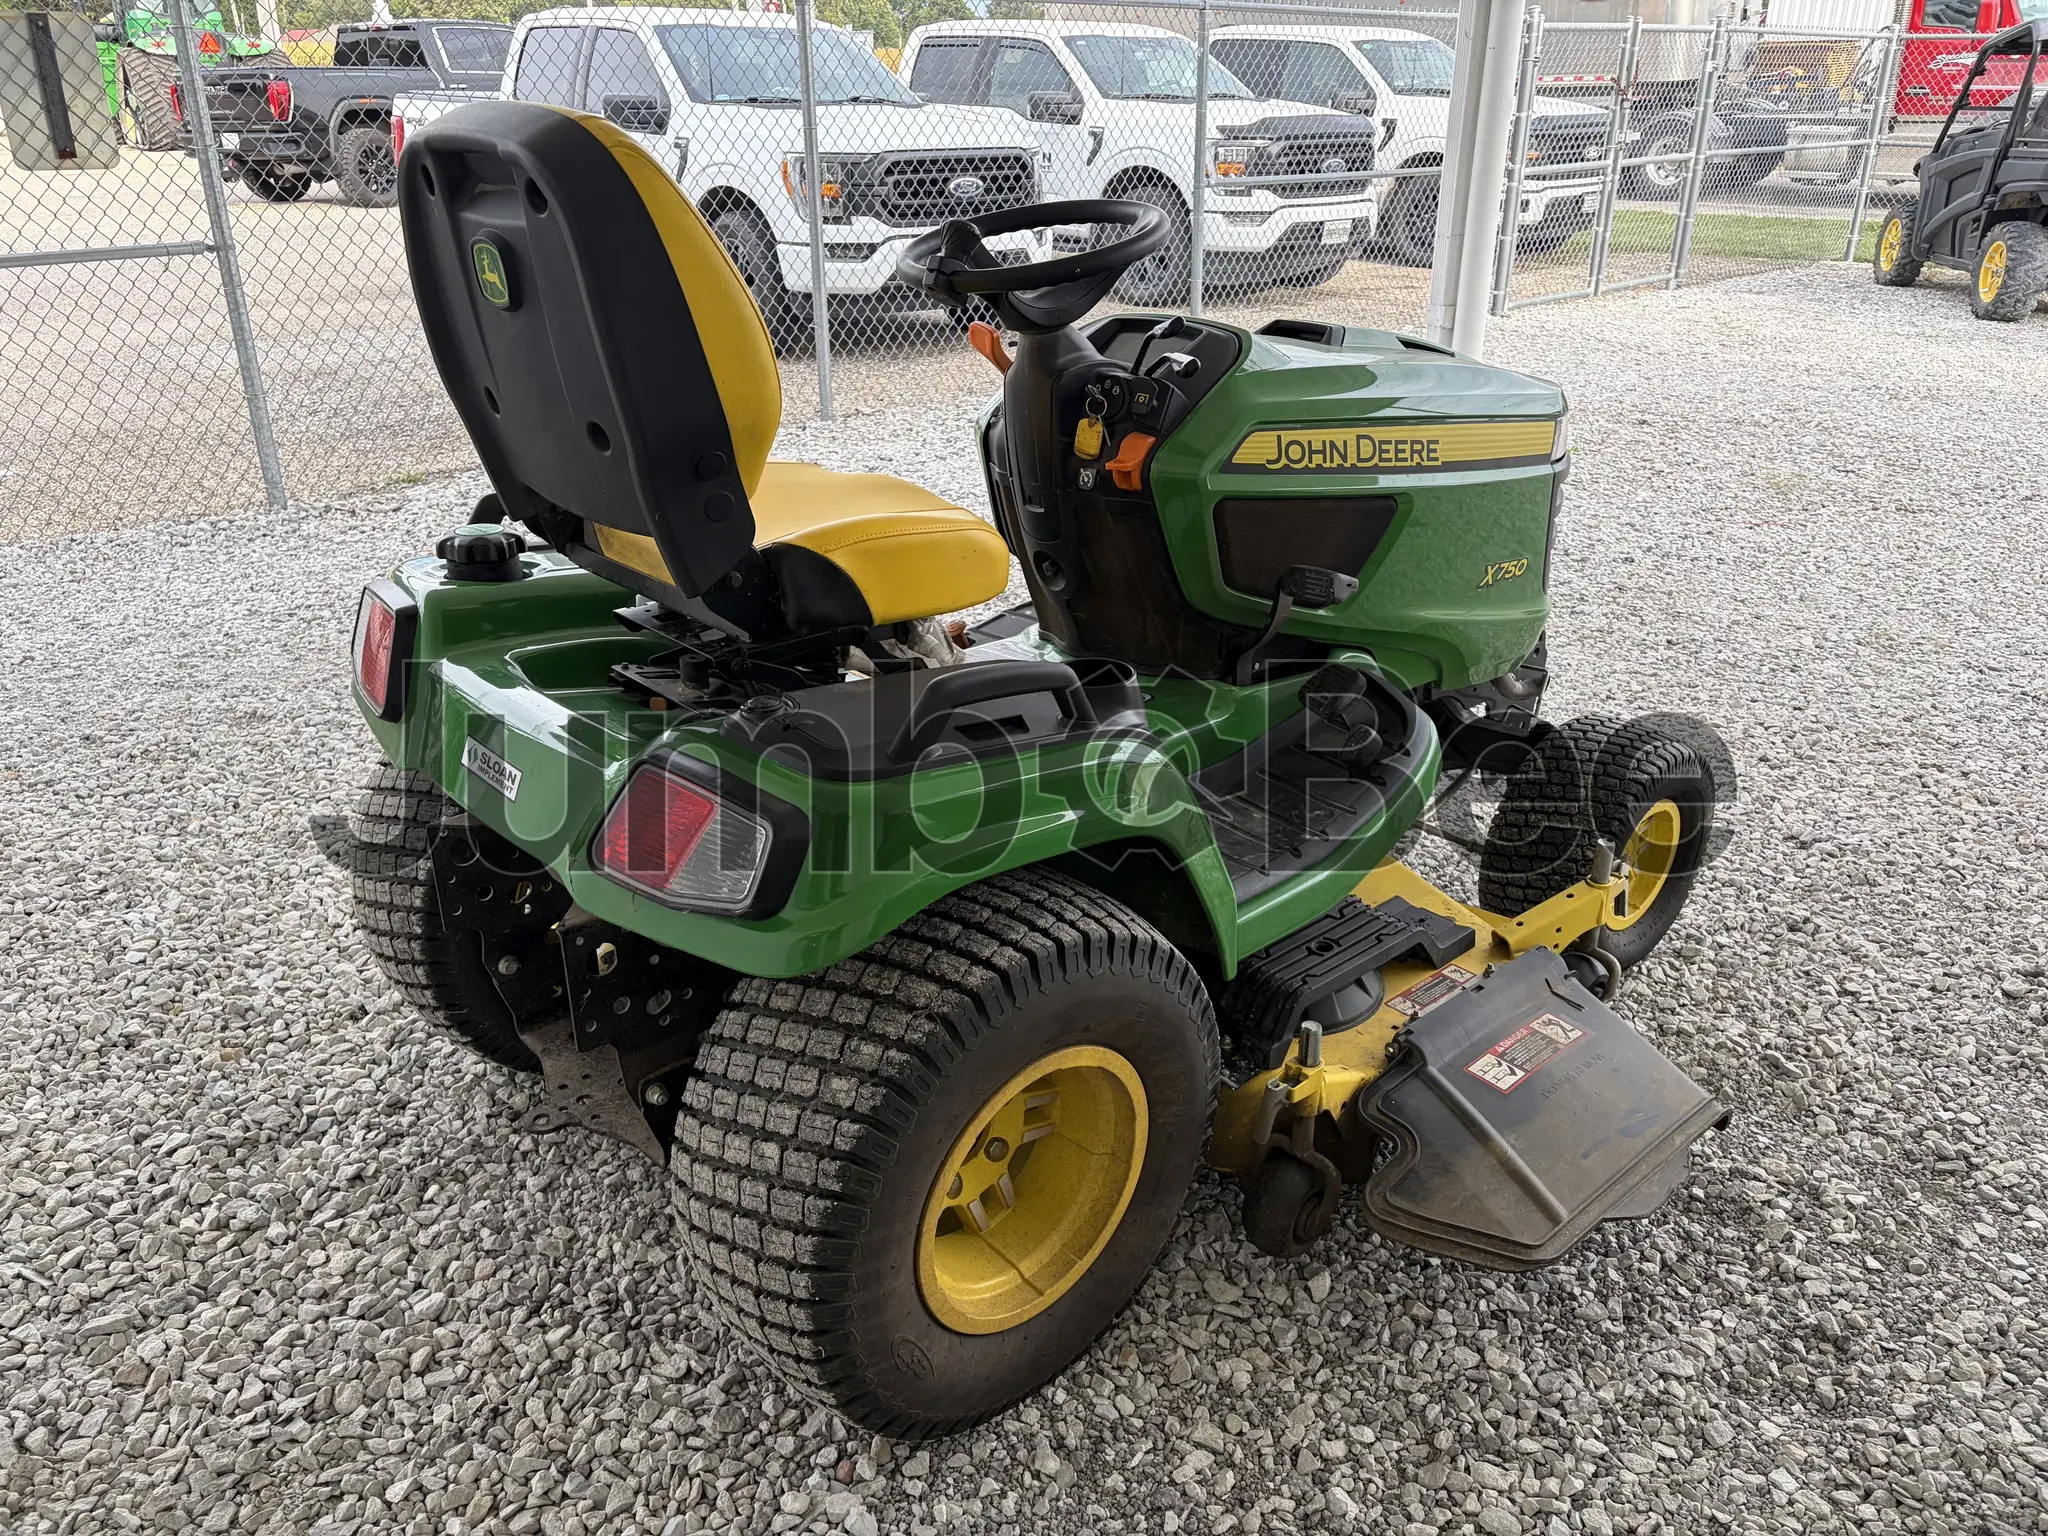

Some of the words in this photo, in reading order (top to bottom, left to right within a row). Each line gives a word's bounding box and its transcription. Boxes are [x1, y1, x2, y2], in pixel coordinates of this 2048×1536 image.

[1265, 434, 1349, 467] JOHN
[1355, 434, 1441, 466] DEERE
[1478, 557, 1528, 587] X750
[477, 764, 514, 794] IMPLEMENT
[480, 751, 518, 786] SLOAN
[1500, 1028, 1529, 1049] DANGER
